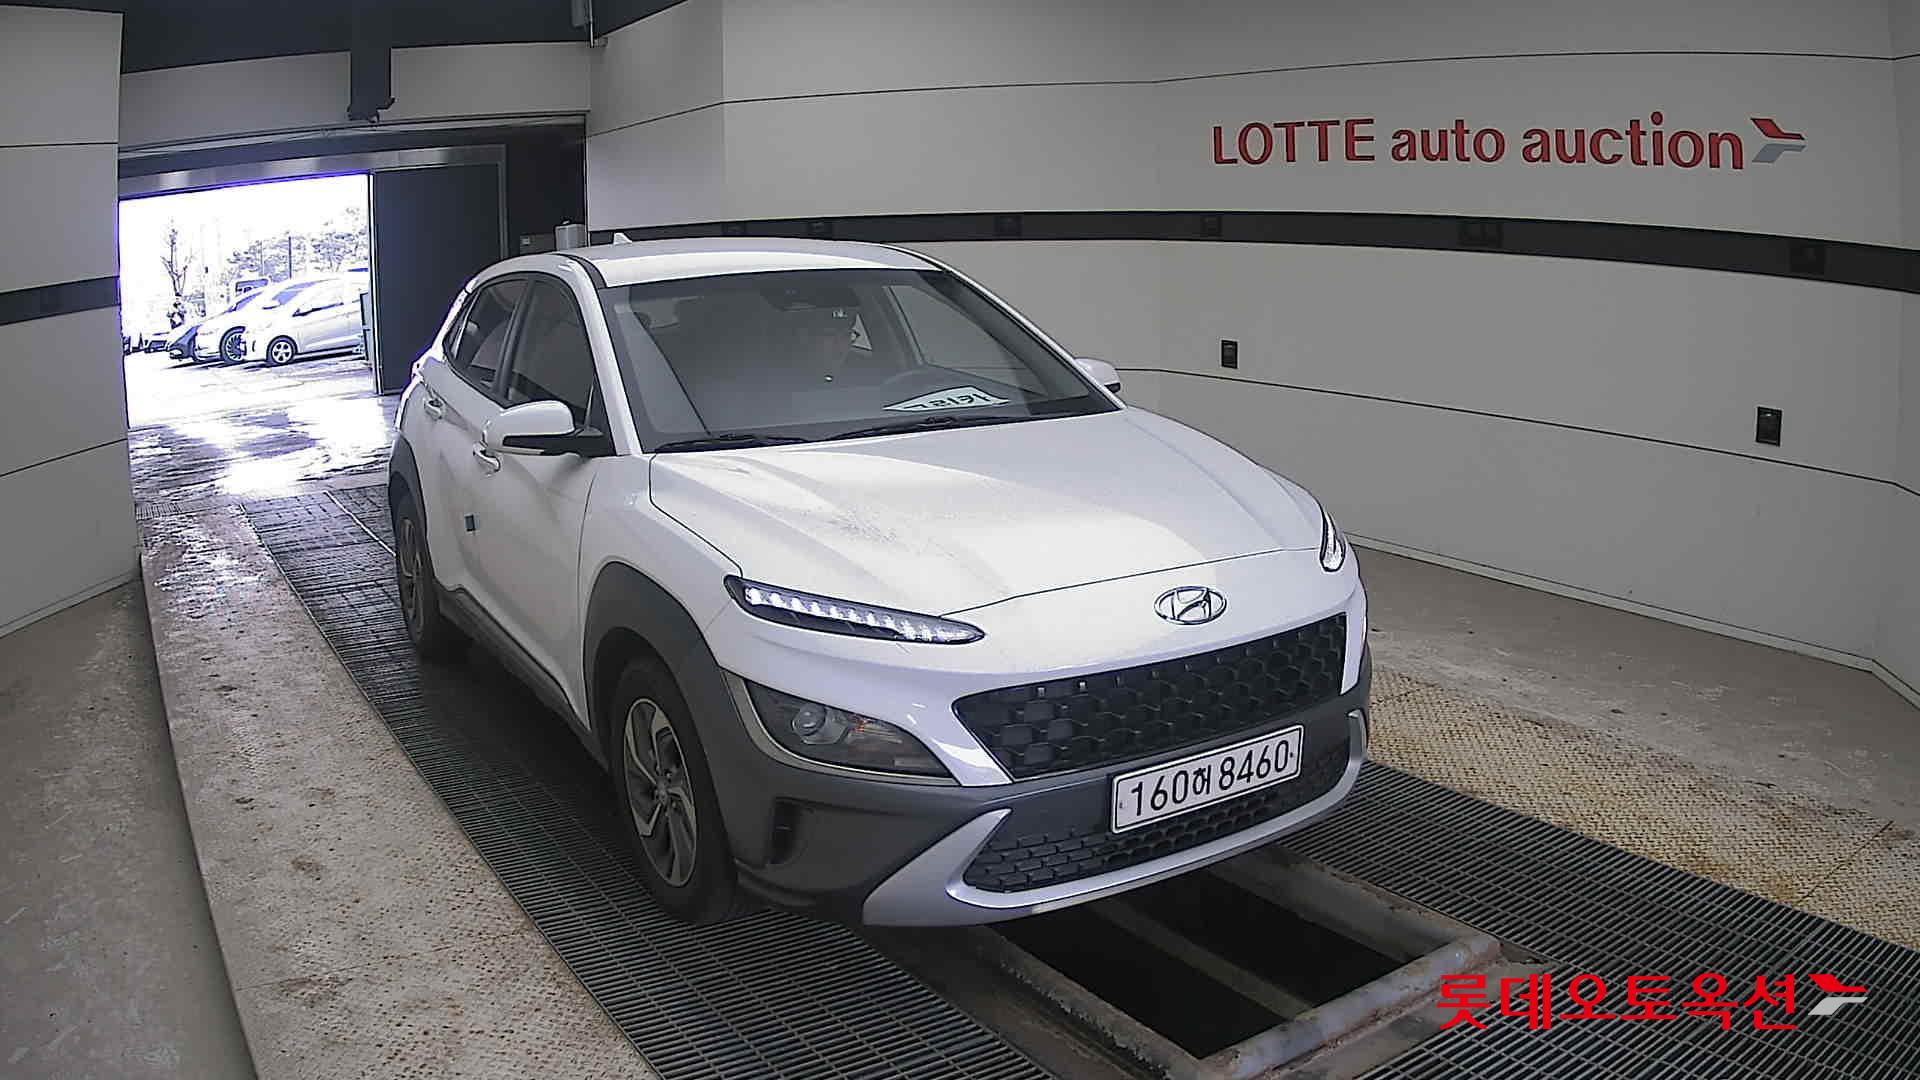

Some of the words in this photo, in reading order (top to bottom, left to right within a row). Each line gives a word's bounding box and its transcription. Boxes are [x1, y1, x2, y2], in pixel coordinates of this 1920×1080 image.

[1213, 118, 1375, 165] LOTTE
[1391, 118, 1506, 163] auto
[1521, 111, 1744, 170] auction
[1130, 764, 1212, 817] 160허
[1218, 739, 1290, 791] 8460
